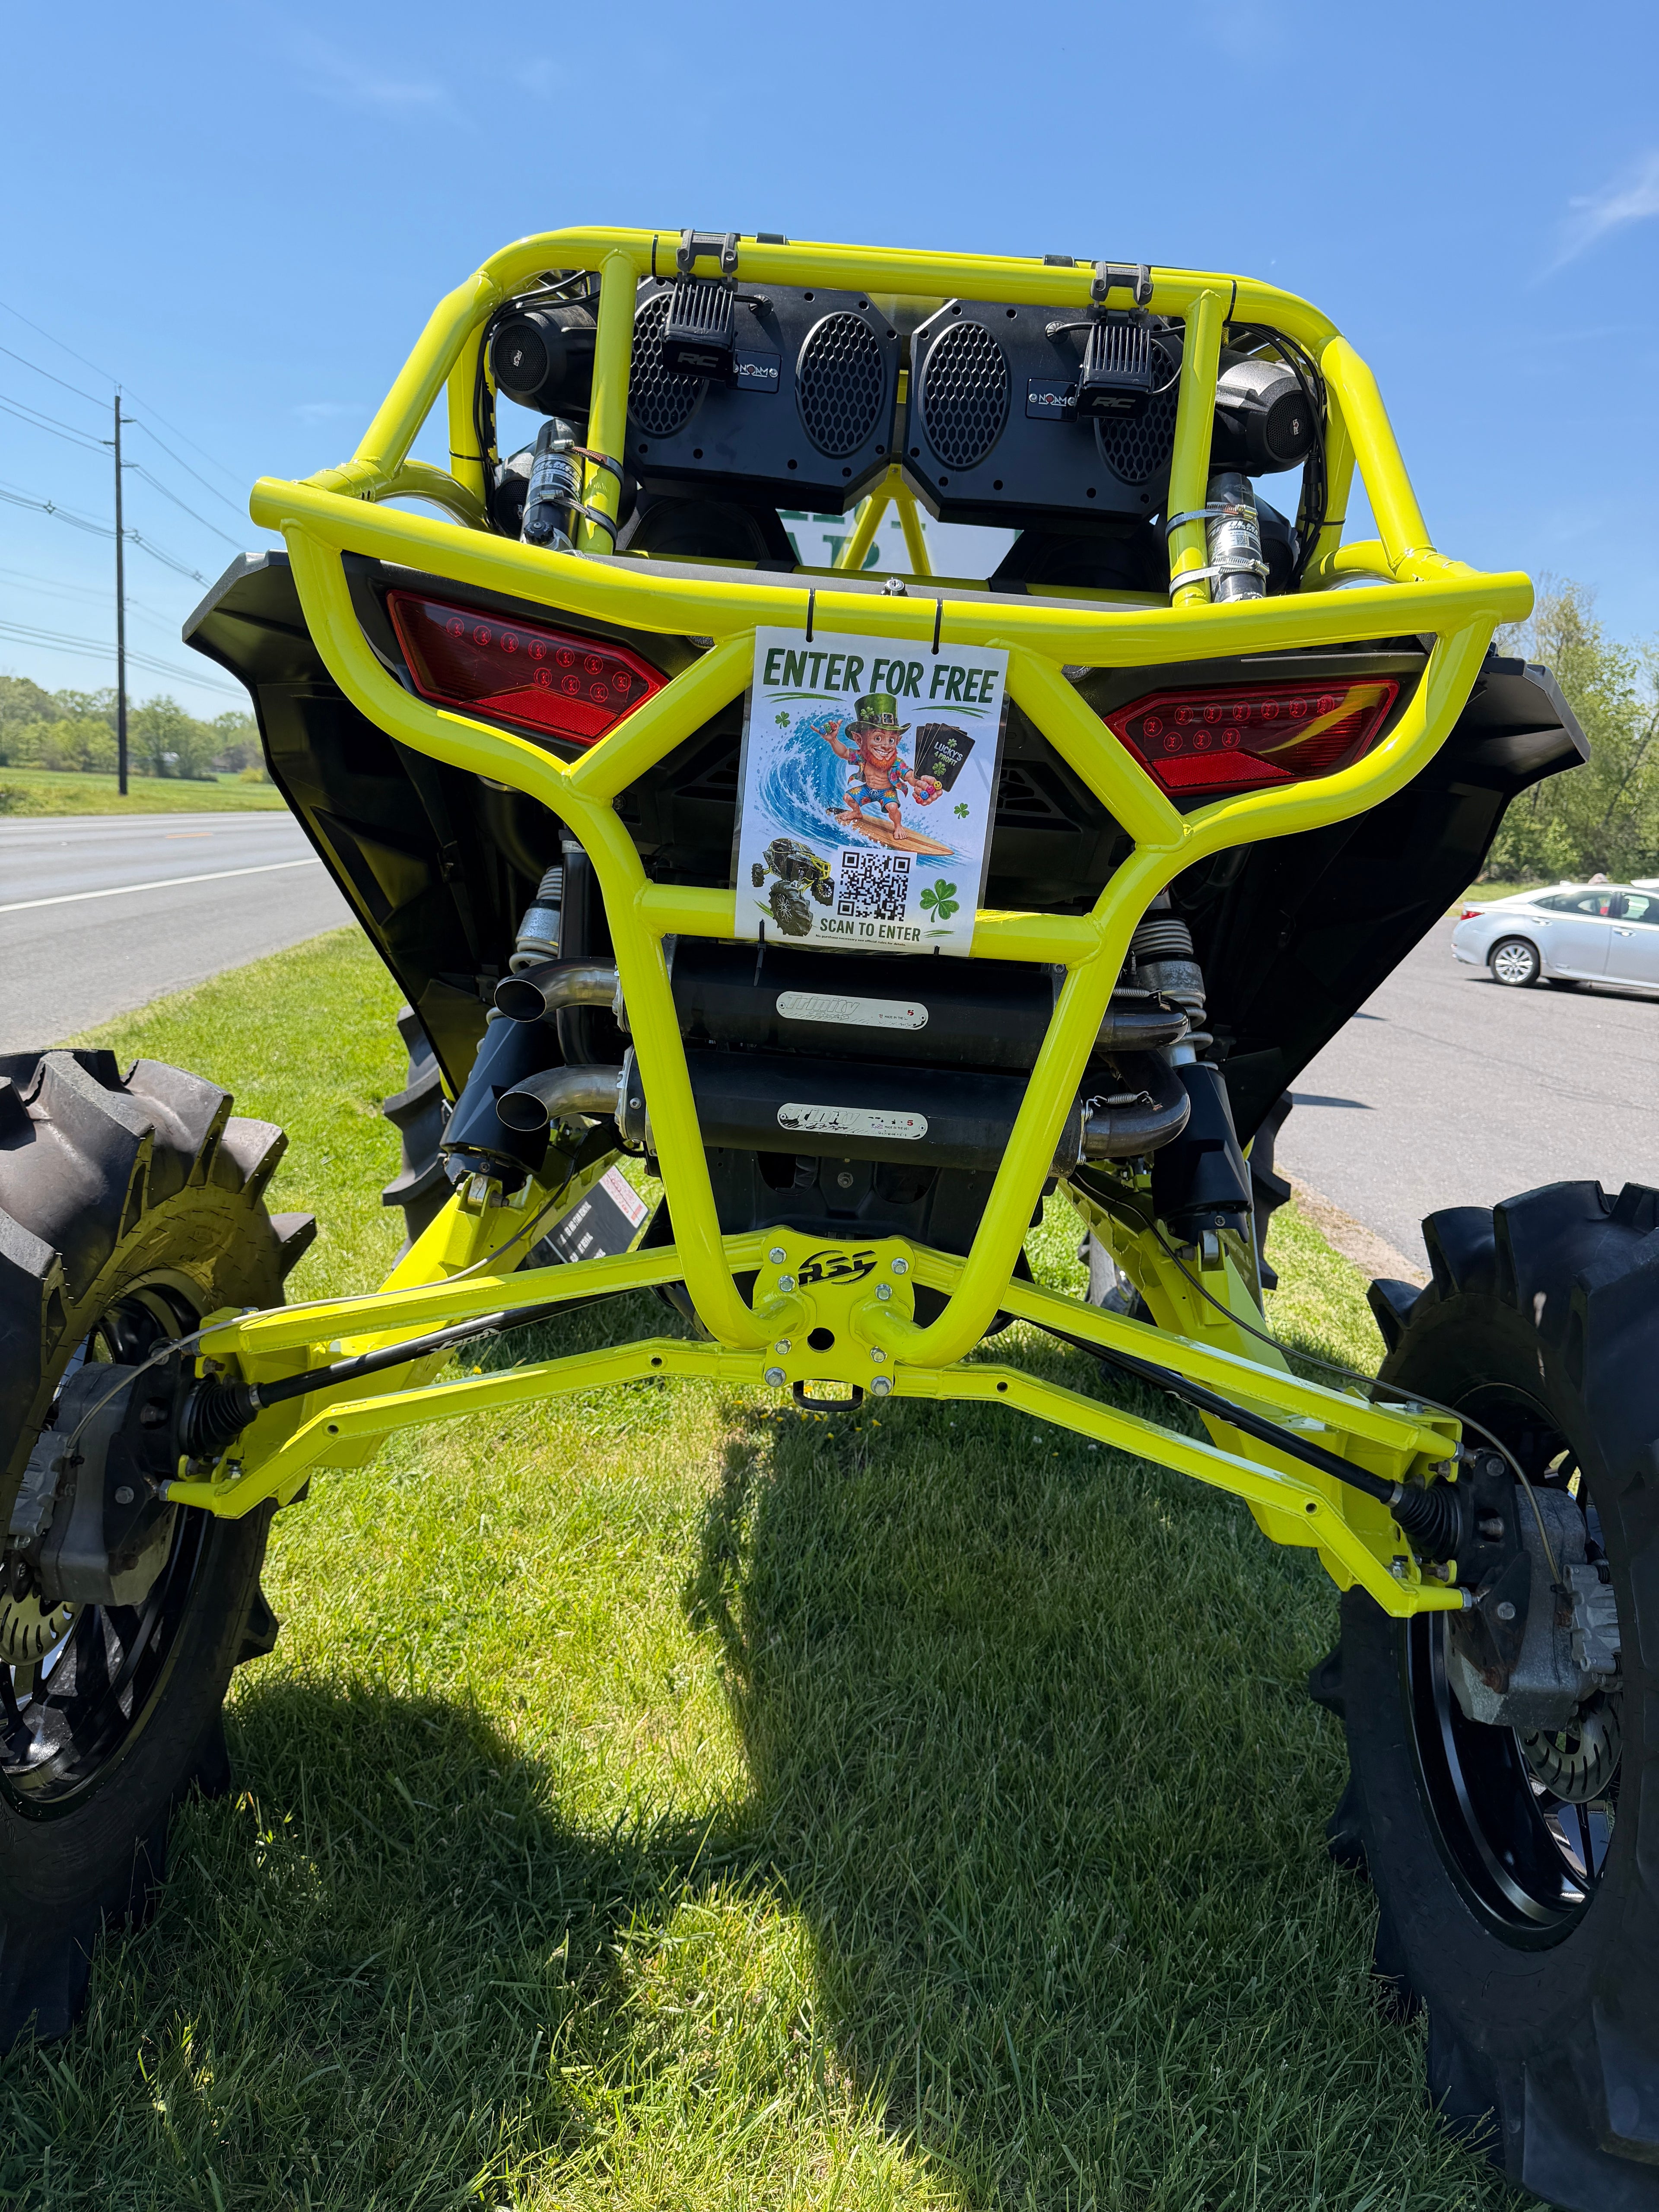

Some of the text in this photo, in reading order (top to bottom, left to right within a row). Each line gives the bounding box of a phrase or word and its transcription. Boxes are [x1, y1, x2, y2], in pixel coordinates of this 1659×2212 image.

[677, 352, 719, 367] RC
[739, 364, 769, 378] NOAM
[1038, 393, 1067, 407] NOAM
[1091, 397, 1136, 408] RC
[763, 648, 999, 703] ENTER FOR FREE
[934, 741, 963, 761] LUCKY'S
[938, 753, 958, 766] PROFIT
[820, 918, 921, 942] SCAN TO ENTER
[786, 994, 860, 1015] Trinity
[788, 1105, 861, 1126] Trinity
